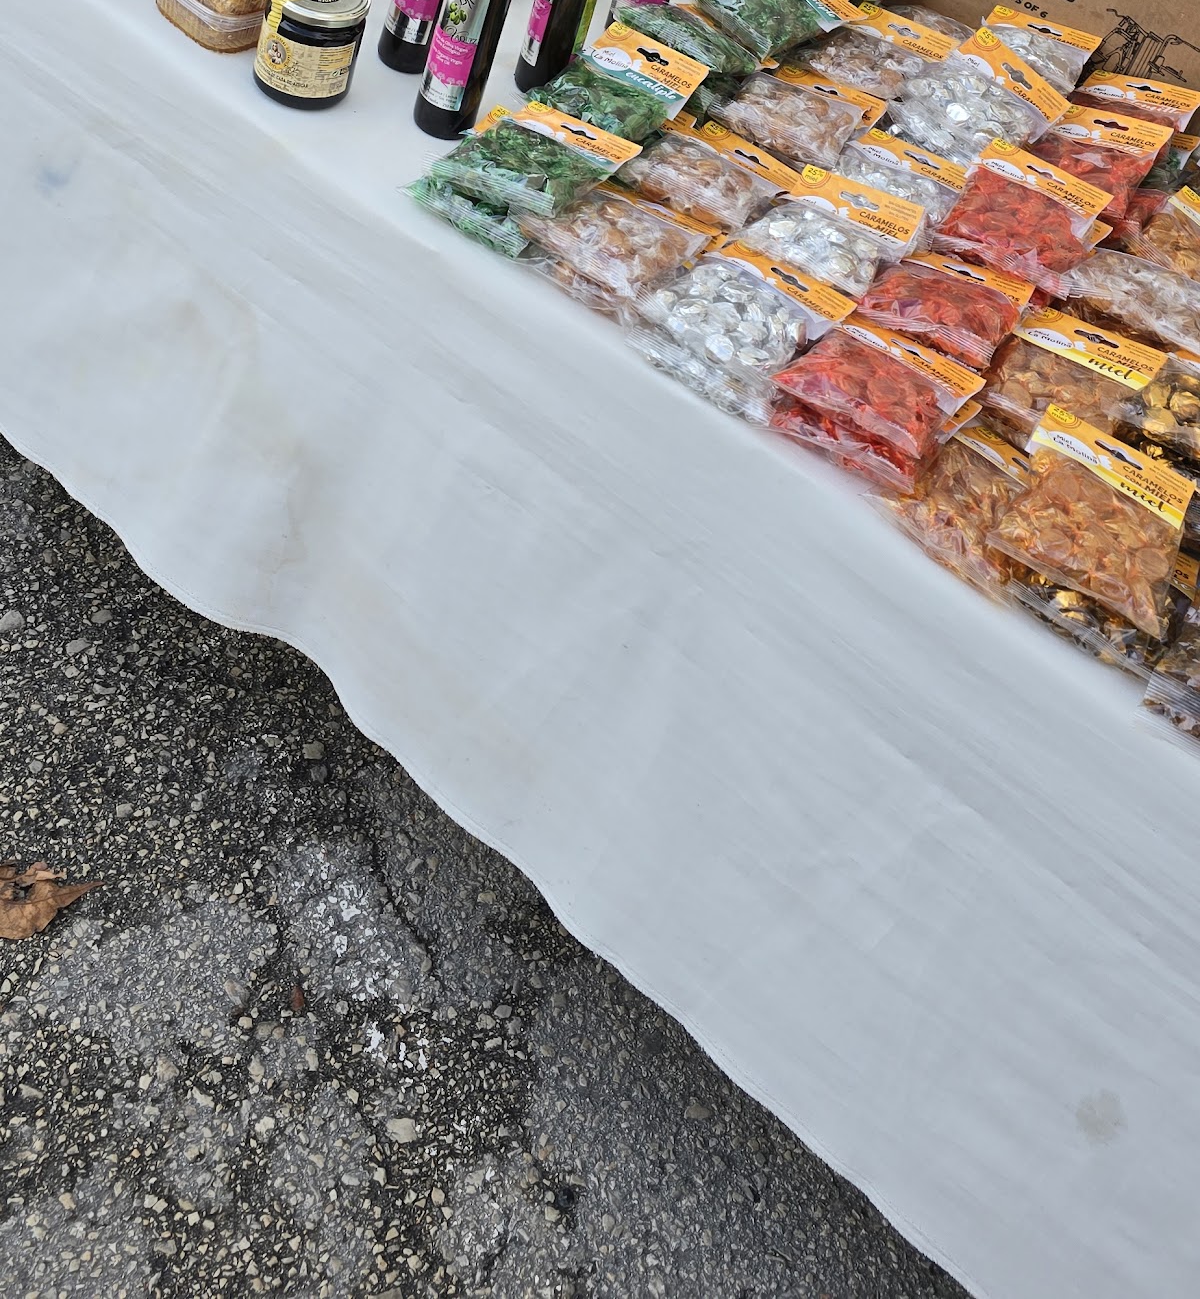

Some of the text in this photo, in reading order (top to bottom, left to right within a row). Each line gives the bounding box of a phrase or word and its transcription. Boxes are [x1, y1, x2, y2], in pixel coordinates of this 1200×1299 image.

[1024, 1, 1040, 12] OF
[1040, 10, 1049, 19] 6
[902, 38, 945, 60] CARAMELOS
[605, 56, 629, 69] Molina
[650, 64, 693, 89] CARAMELOS
[661, 77, 681, 92] MIEL
[1145, 93, 1191, 109] CARAMELOS
[575, 136, 623, 161] CARAMELOS
[1110, 131, 1157, 148] CARAMELOS
[804, 173, 819, 184] miel
[807, 167, 825, 178] 25%
[920, 166, 964, 191] CARAMELO
[1046, 181, 1098, 210] CARAMELOS
[859, 211, 911, 236] CARAMELOS
[872, 223, 900, 239] MIEL
[786, 285, 836, 320] CARAMELOS
[1088, 358, 1133, 381] miel
[1097, 345, 1155, 373] CARAMELOS
[1116, 359, 1144, 374] MIEL
[911, 355, 968, 392] CARAMELOS
[1051, 411, 1067, 423] miel
[1053, 436, 1098, 465] La Molina
[1122, 464, 1185, 505] CARAMELOS
[1144, 484, 1174, 507] MIEL
[1119, 481, 1168, 514] miel
